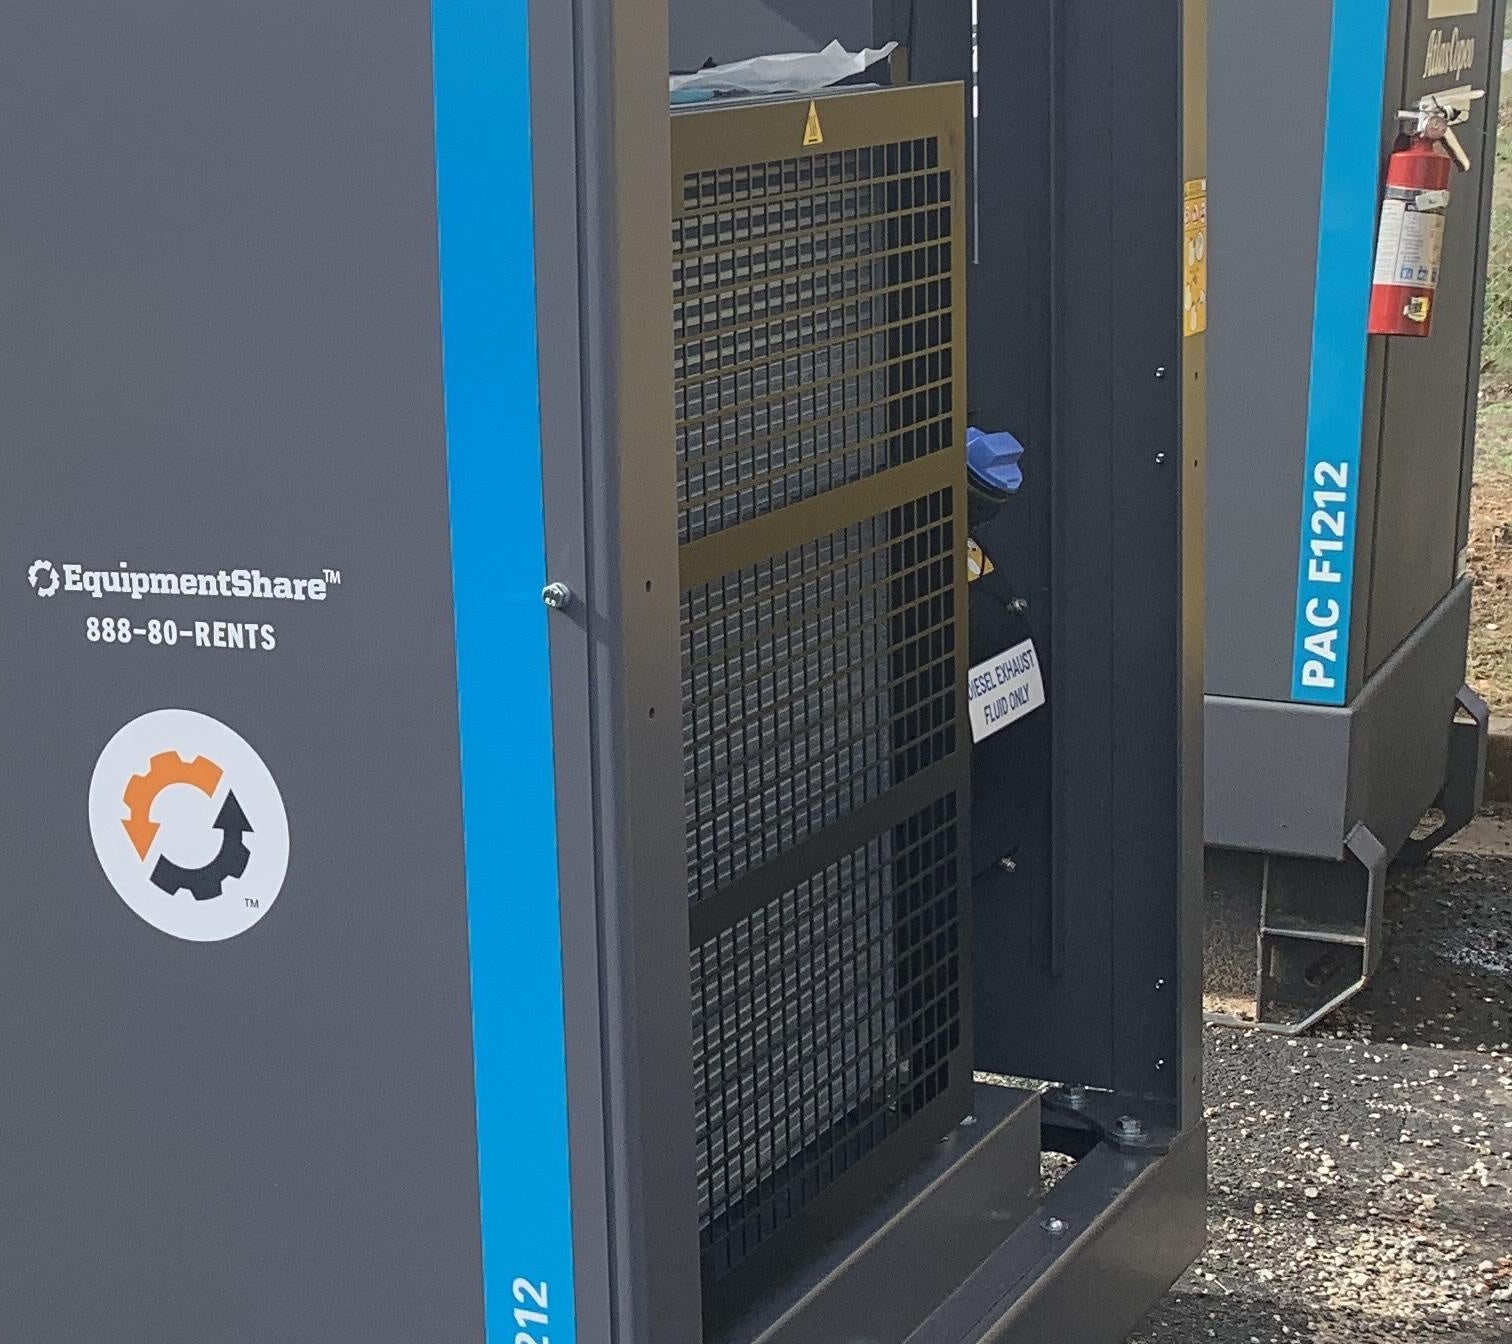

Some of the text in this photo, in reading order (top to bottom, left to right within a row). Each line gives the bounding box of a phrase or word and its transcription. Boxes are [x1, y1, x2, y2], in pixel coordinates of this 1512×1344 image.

[1302, 461, 1348, 688] PAC F1212
[86, 616, 276, 650] 888-80-RENTS
[995, 649, 1035, 684] EXHAUST
[984, 684, 1030, 725] FLUID ONLY
